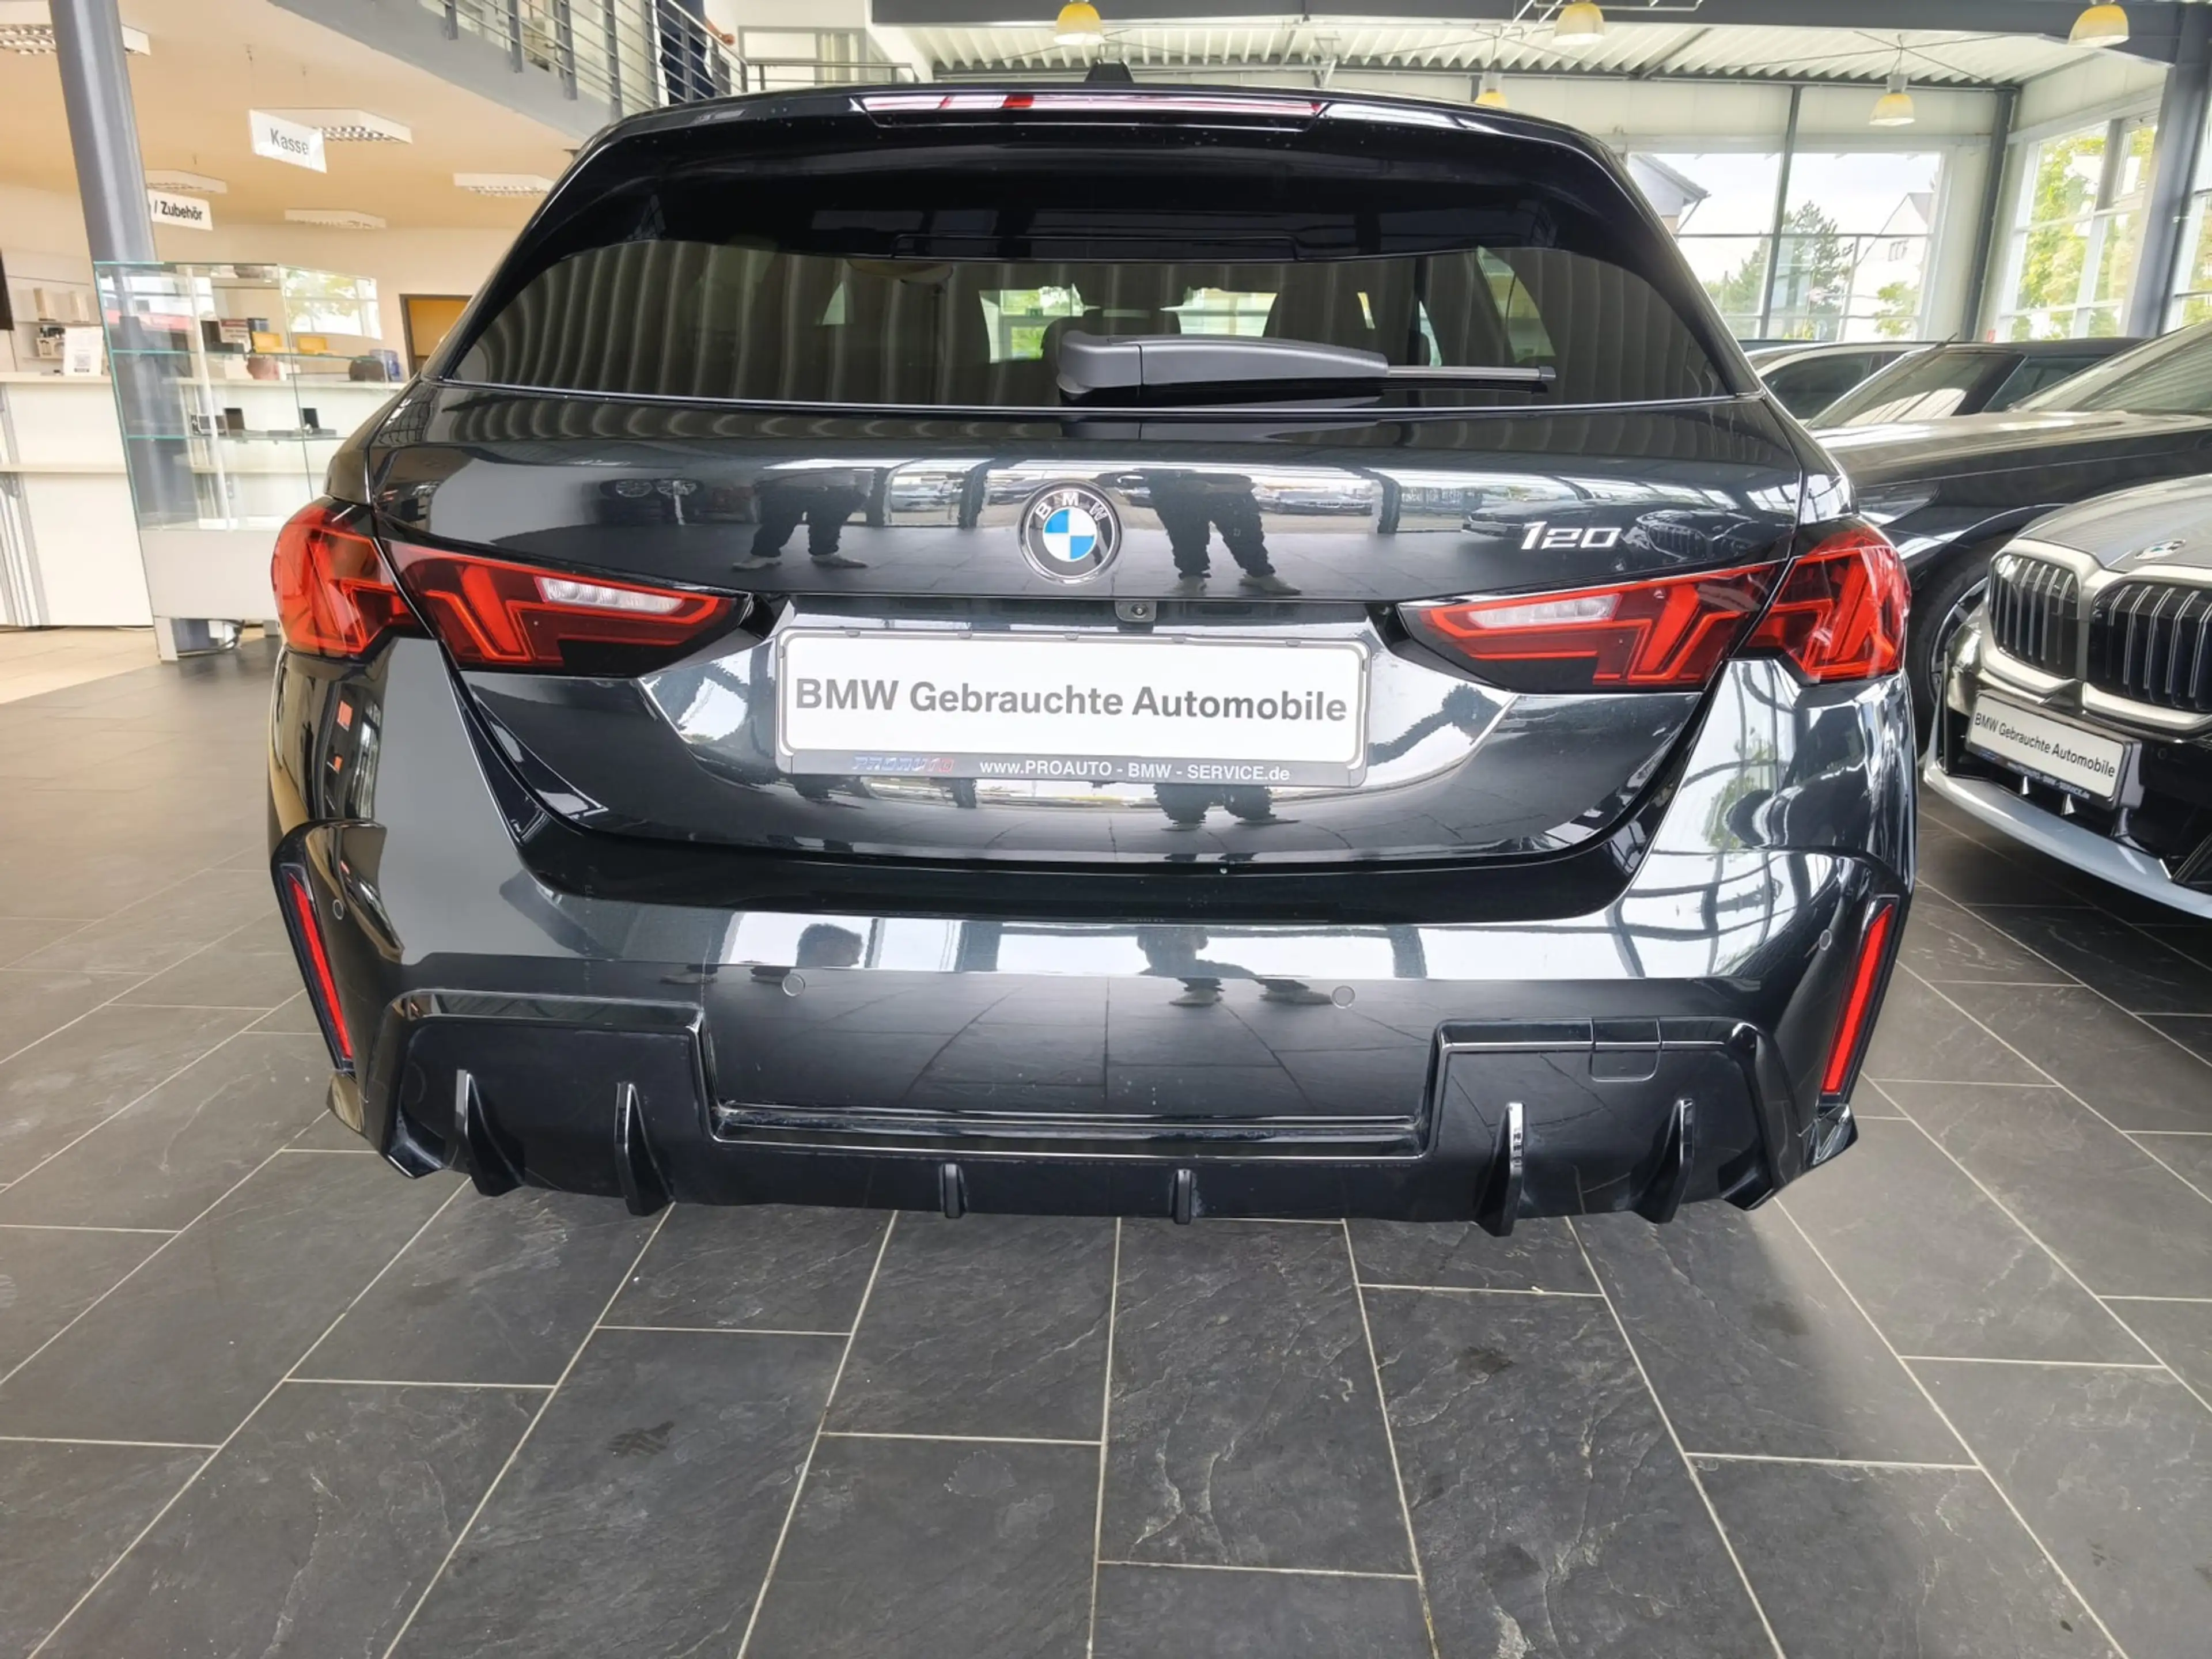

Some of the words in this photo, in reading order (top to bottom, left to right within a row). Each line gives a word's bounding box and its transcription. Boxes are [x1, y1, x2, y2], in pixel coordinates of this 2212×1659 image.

[270, 127, 309, 155] Kasse
[160, 200, 203, 221] Zubehör
[1035, 491, 1108, 521] BMW
[1521, 521, 1622, 550] 120
[796, 677, 899, 710] BMW
[910, 681, 1123, 715] Gebrauchte
[1131, 686, 1347, 721] Automobile
[1975, 712, 1999, 732] BMW
[1998, 722, 2051, 753] Gebrauchte
[2052, 743, 2115, 777] Automobile
[979, 760, 1112, 777] www.PROAUTO
[1128, 763, 1172, 778] BMW
[1187, 765, 1290, 781] SERVICE.de
